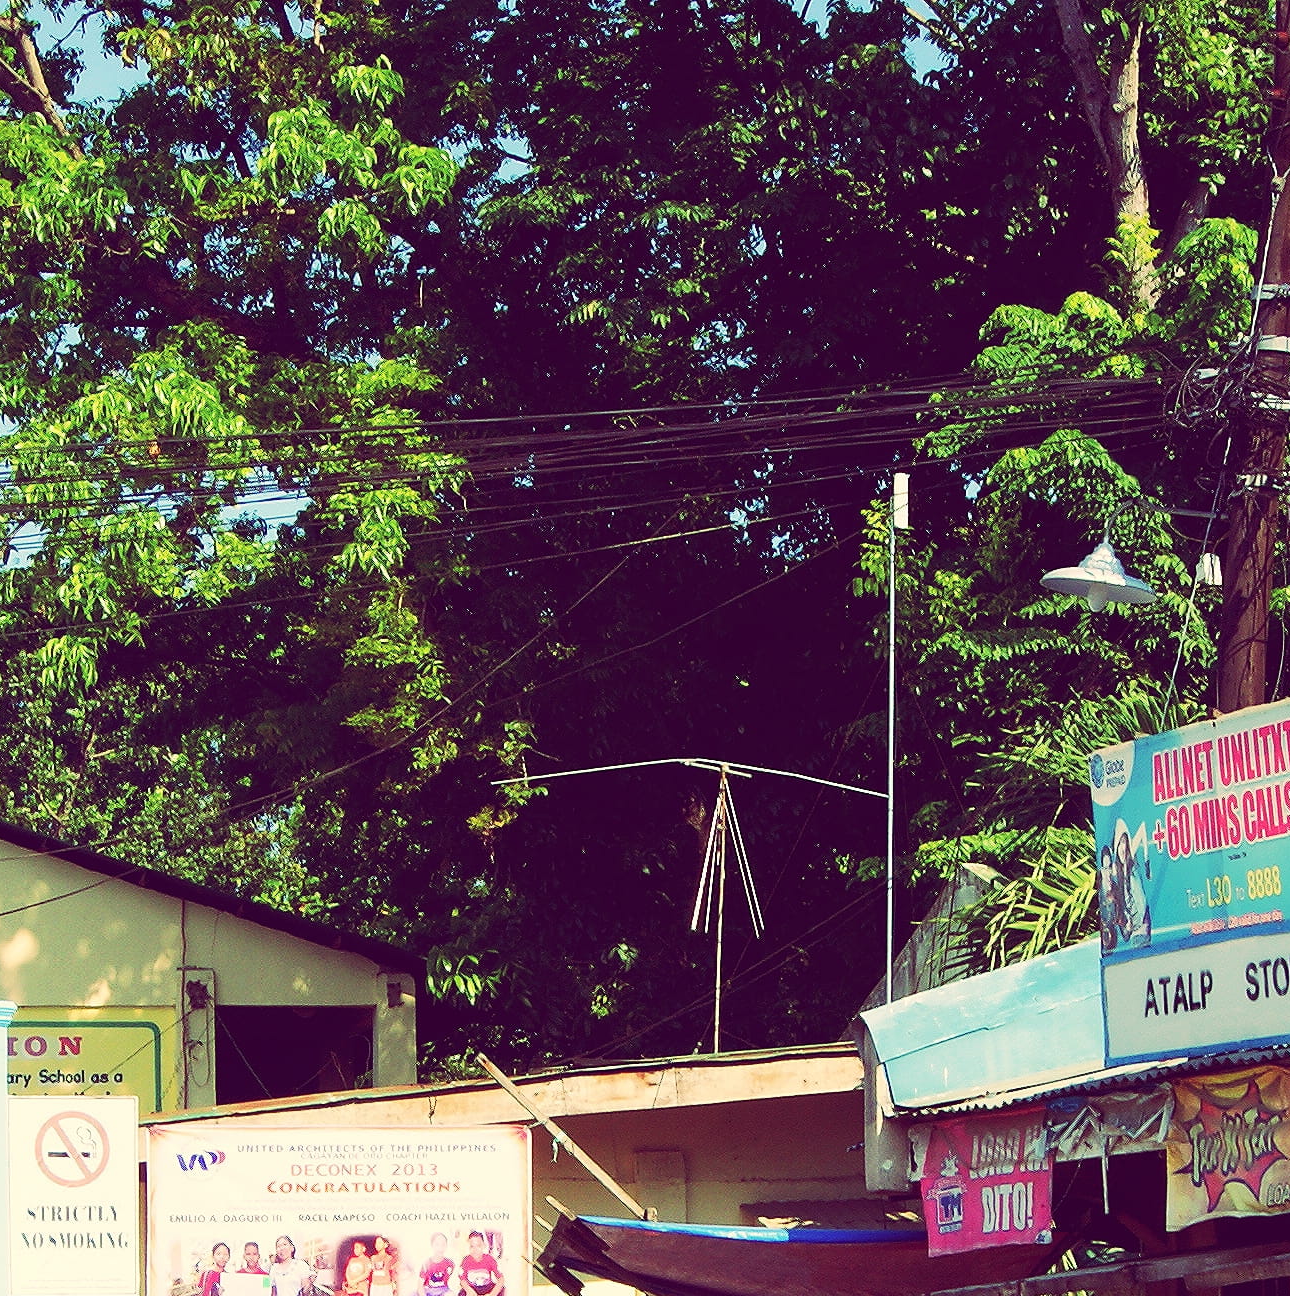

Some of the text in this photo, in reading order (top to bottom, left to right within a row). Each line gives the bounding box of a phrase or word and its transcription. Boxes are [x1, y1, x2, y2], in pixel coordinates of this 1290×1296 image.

[1153, 741, 1213, 802] ALLNET
[1193, 794, 1242, 853] MINS
[1206, 875, 1232, 908] L30
[1247, 865, 1282, 900] 8888
[1145, 969, 1213, 1018] ATALP
[39, 1069, 85, 1084] School
[91, 1073, 109, 1084] as
[113, 1073, 123, 1084] a
[237, 1144, 284, 1153] UNITED
[289, 1144, 365, 1153] ARCHITECTS
[370, 1144, 385, 1153] OF
[417, 1144, 497, 1153] PHILIPPINES
[290, 1163, 439, 1177] DECONEX 2013
[267, 1181, 461, 1194] CONGRATULATIONS
[27, 1205, 118, 1221] STRICTLY
[981, 1181, 1034, 1234] DITO!
[21, 1232, 128, 1248] NO SMOKING
